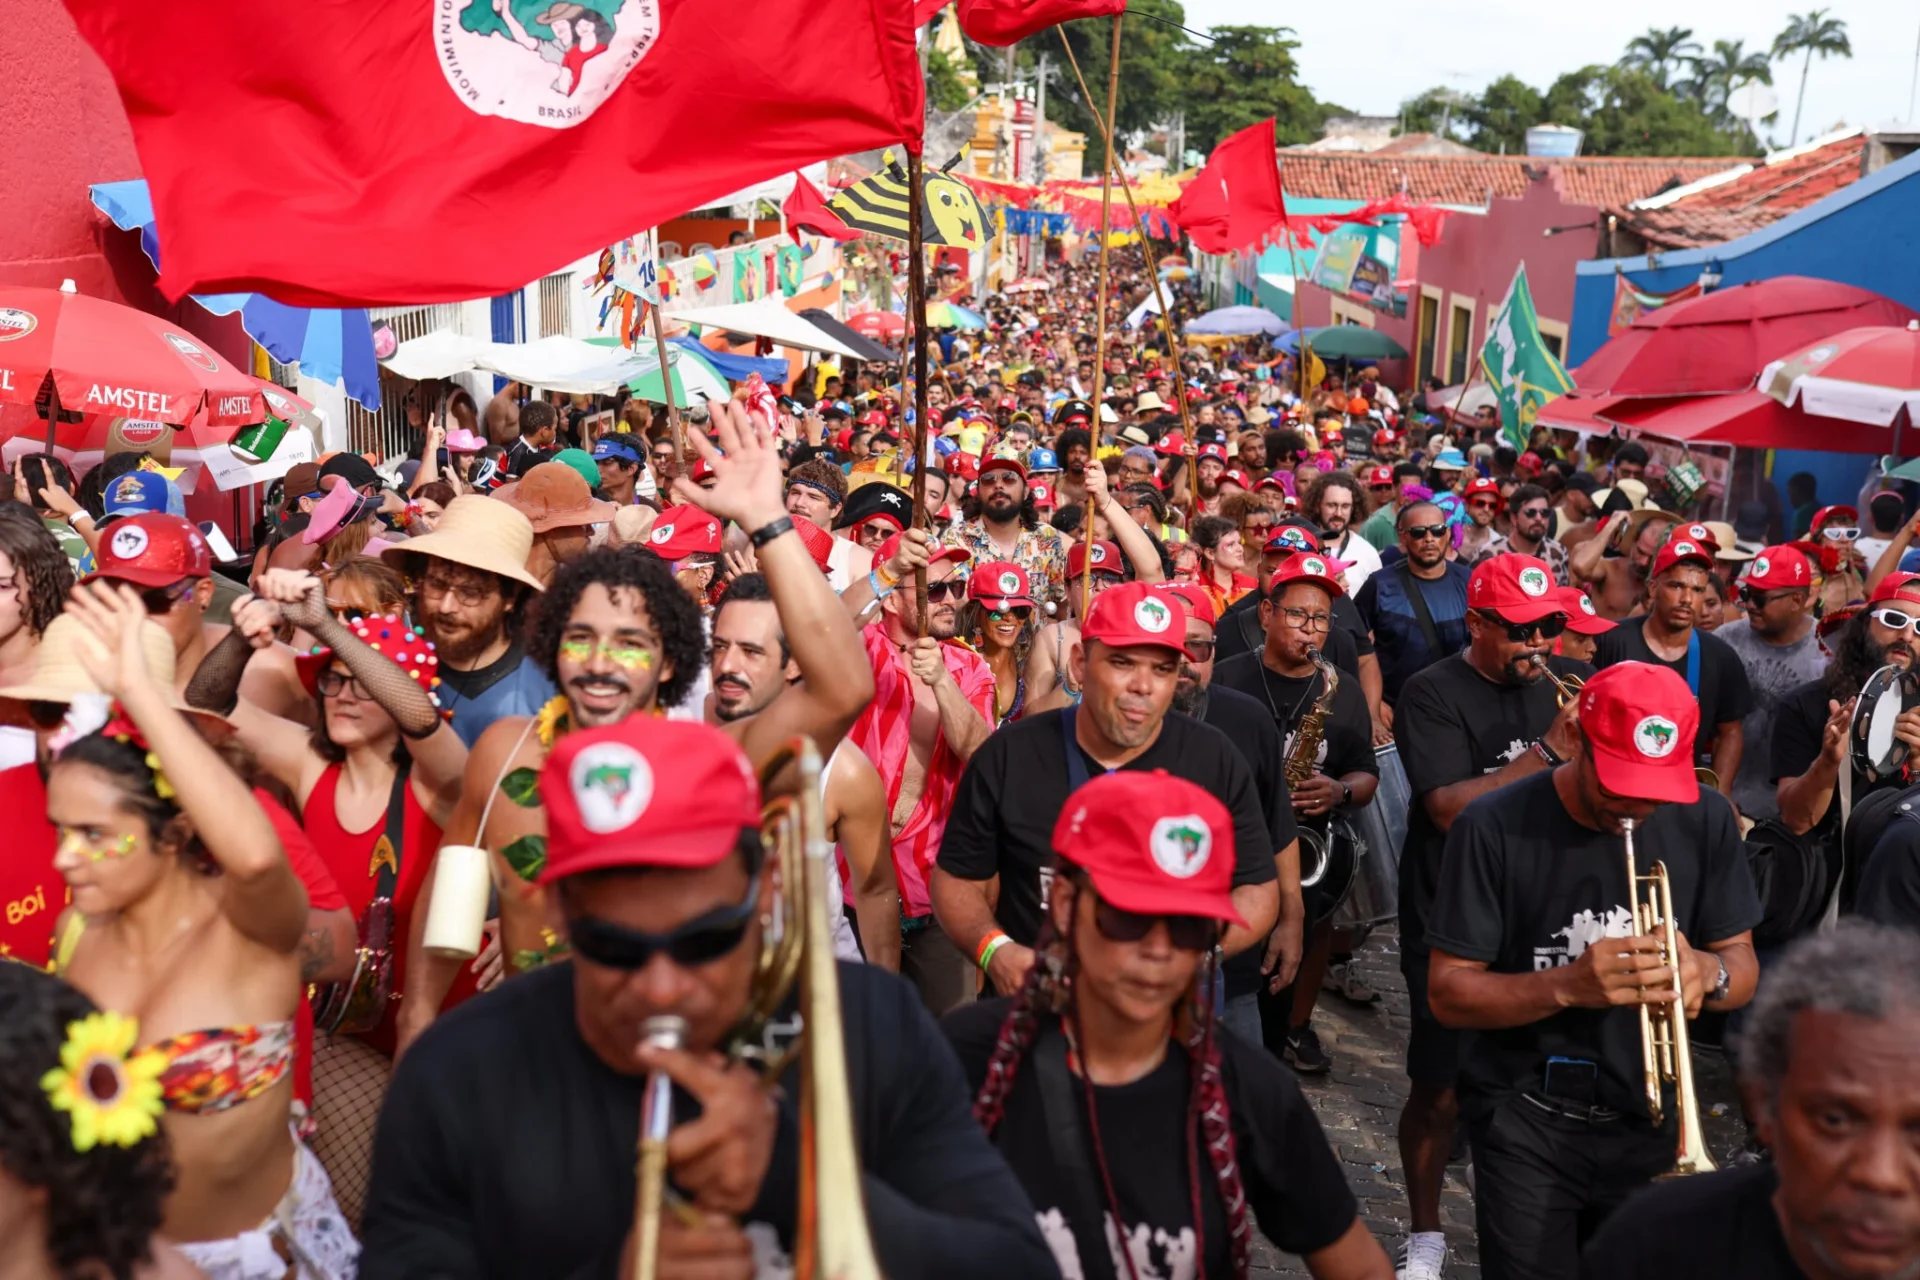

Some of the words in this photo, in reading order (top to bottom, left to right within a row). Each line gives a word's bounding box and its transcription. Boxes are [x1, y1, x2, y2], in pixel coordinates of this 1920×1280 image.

[441, 0, 480, 101] MOVIMENTO
[538, 105, 582, 119] BRASIL
[87, 384, 172, 413] AMSTEL
[218, 396, 252, 417] AMSTEL
